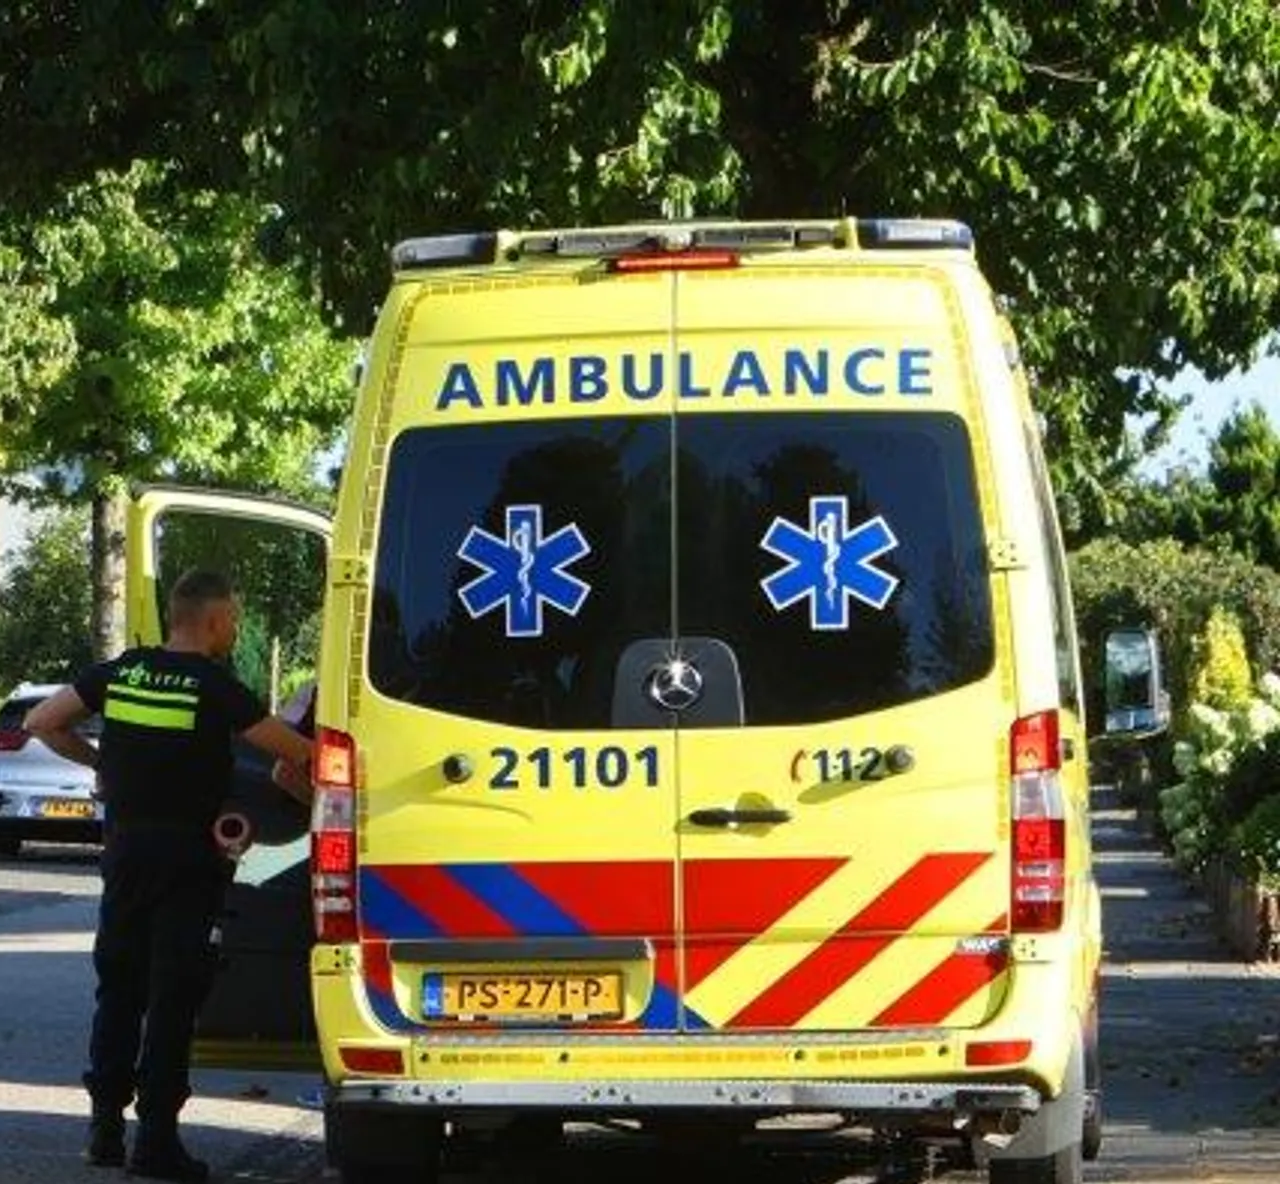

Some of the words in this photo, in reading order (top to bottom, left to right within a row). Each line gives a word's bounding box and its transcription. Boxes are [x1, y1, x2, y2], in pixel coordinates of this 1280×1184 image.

[435, 348, 933, 410] AMBULANCE
[489, 745, 659, 789] 21101
[812, 749, 881, 782] 112
[458, 980, 601, 1009] PS-271-P
